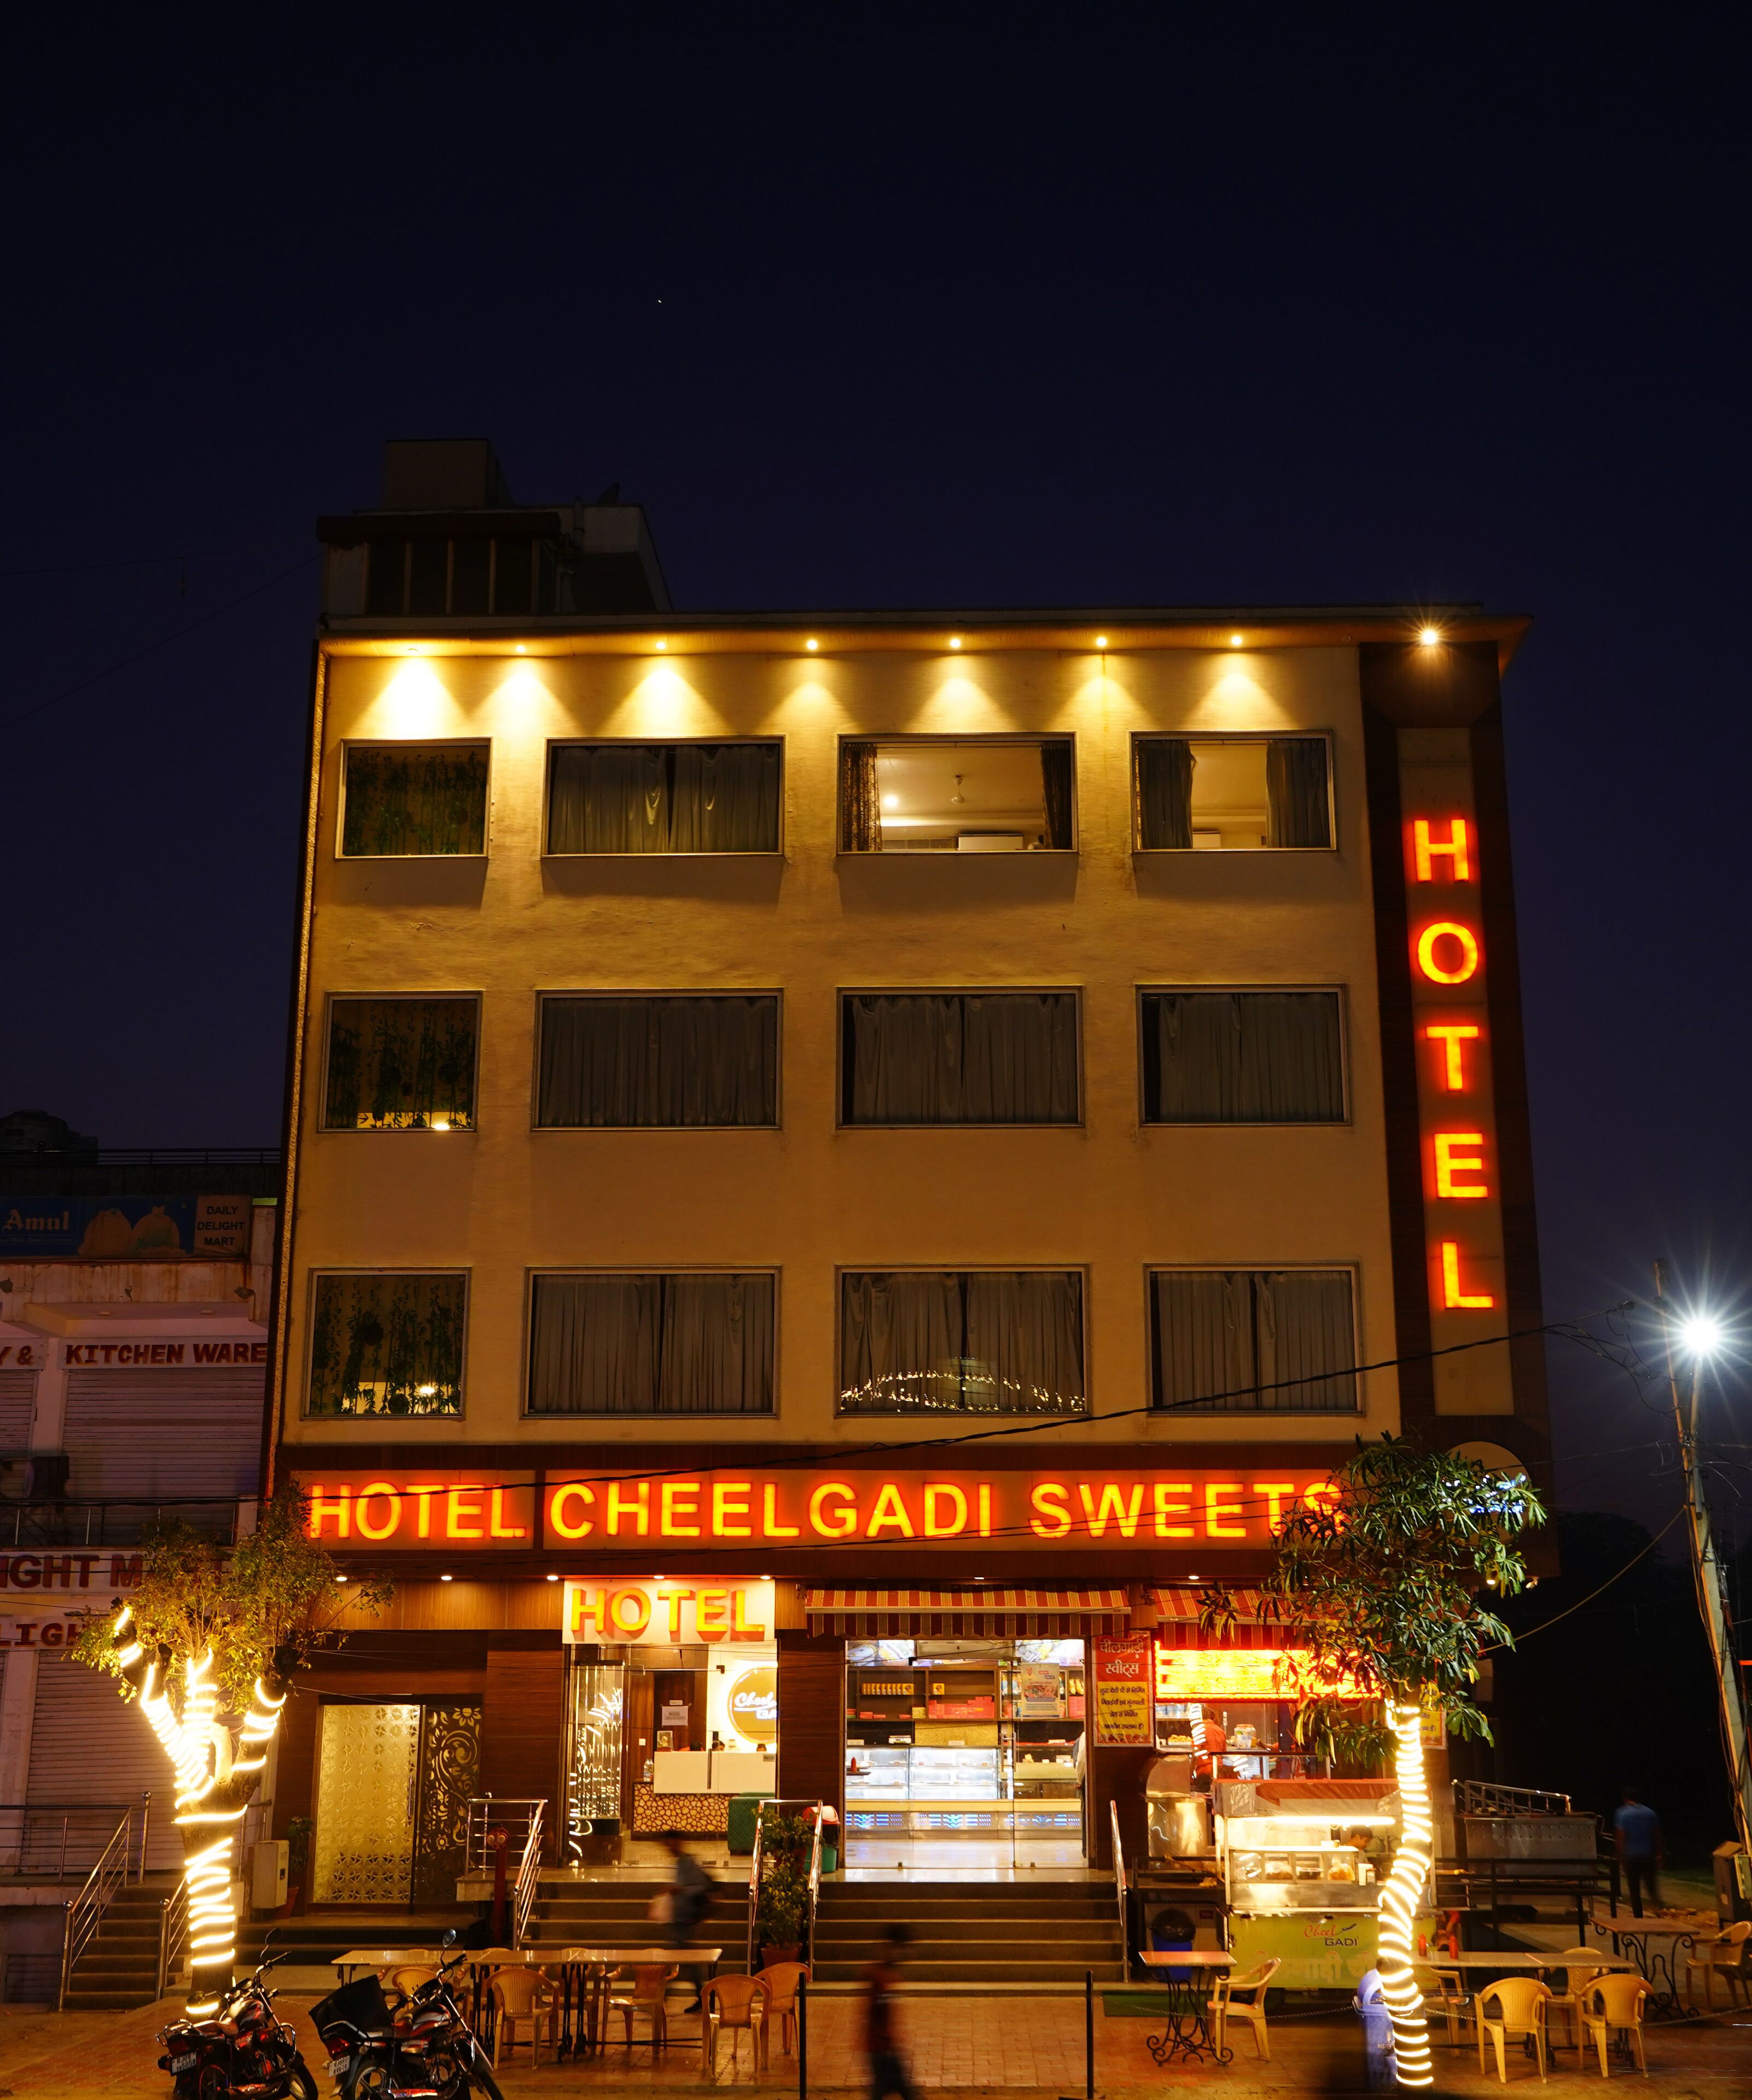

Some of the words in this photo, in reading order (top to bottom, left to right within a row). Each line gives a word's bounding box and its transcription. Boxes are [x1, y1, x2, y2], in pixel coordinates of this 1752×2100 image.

[1412, 819, 1494, 1309] HOTEL
[2, 1208, 70, 1231] Amul
[206, 1206, 238, 1215] DAILY
[197, 1221, 245, 1231] DELIGHT
[203, 1237, 235, 1246] MART
[17, 1345, 34, 1366] &
[65, 1344, 185, 1366] KITCHEN
[193, 1343, 268, 1364] WARE
[309, 1481, 527, 1541] HOTEL
[571, 1587, 766, 1639] HOTEL
[1303, 1924, 1337, 1939] Cheel
[1324, 1938, 1358, 1947] GADI
